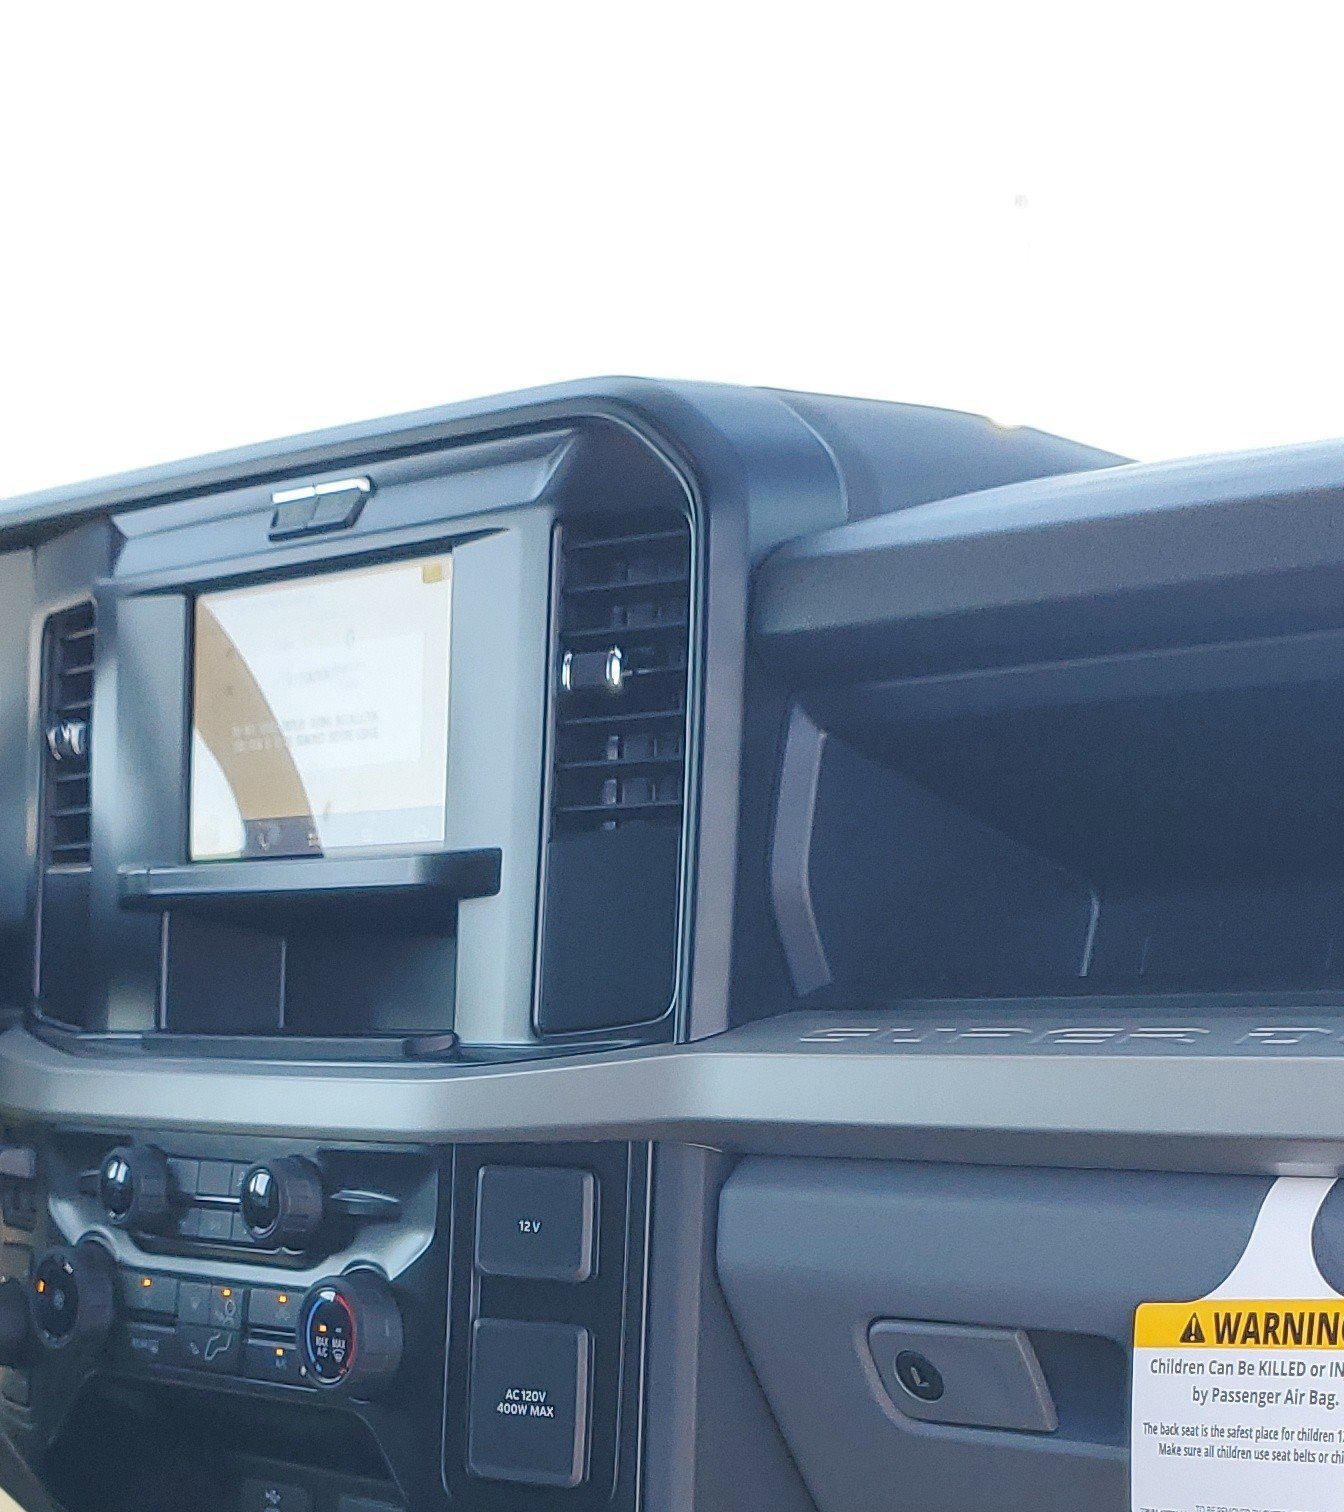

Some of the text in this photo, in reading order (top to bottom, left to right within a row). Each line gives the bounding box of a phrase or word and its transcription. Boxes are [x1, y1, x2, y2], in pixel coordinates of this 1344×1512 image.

[799, 1026, 1211, 1045] SUPER
[1150, 1358, 1205, 1375] Children
[1208, 1360, 1234, 1376] Can
[1237, 1360, 1255, 1376] Be
[1258, 1360, 1306, 1377] KILLED
[1310, 1364, 1326, 1378] or
[505, 1388, 547, 1403] AC 120V
[1192, 1386, 1340, 1410] by Passenger Air Bag.
[497, 1401, 554, 1418] 400W MAX
[1143, 1422, 1157, 1435] The
[1160, 1422, 1179, 1436] back
[1181, 1425, 1199, 1437] seat
[1201, 1424, 1208, 1437] is
[1210, 1424, 1225, 1438] the
[1227, 1425, 1253, 1439] safest
[1255, 1426, 1279, 1443] place
[1281, 1427, 1295, 1441] for
[1297, 1427, 1335, 1443] children
[1158, 1443, 1182, 1456] Make
[1183, 1446, 1202, 1457] sure
[1203, 1445, 1214, 1458] all
[1216, 1445, 1252, 1460] children
[1254, 1449, 1270, 1461] use
[1271, 1450, 1291, 1462] seat
[1293, 1448, 1316, 1463] belts
[1318, 1452, 1329, 1464] or
